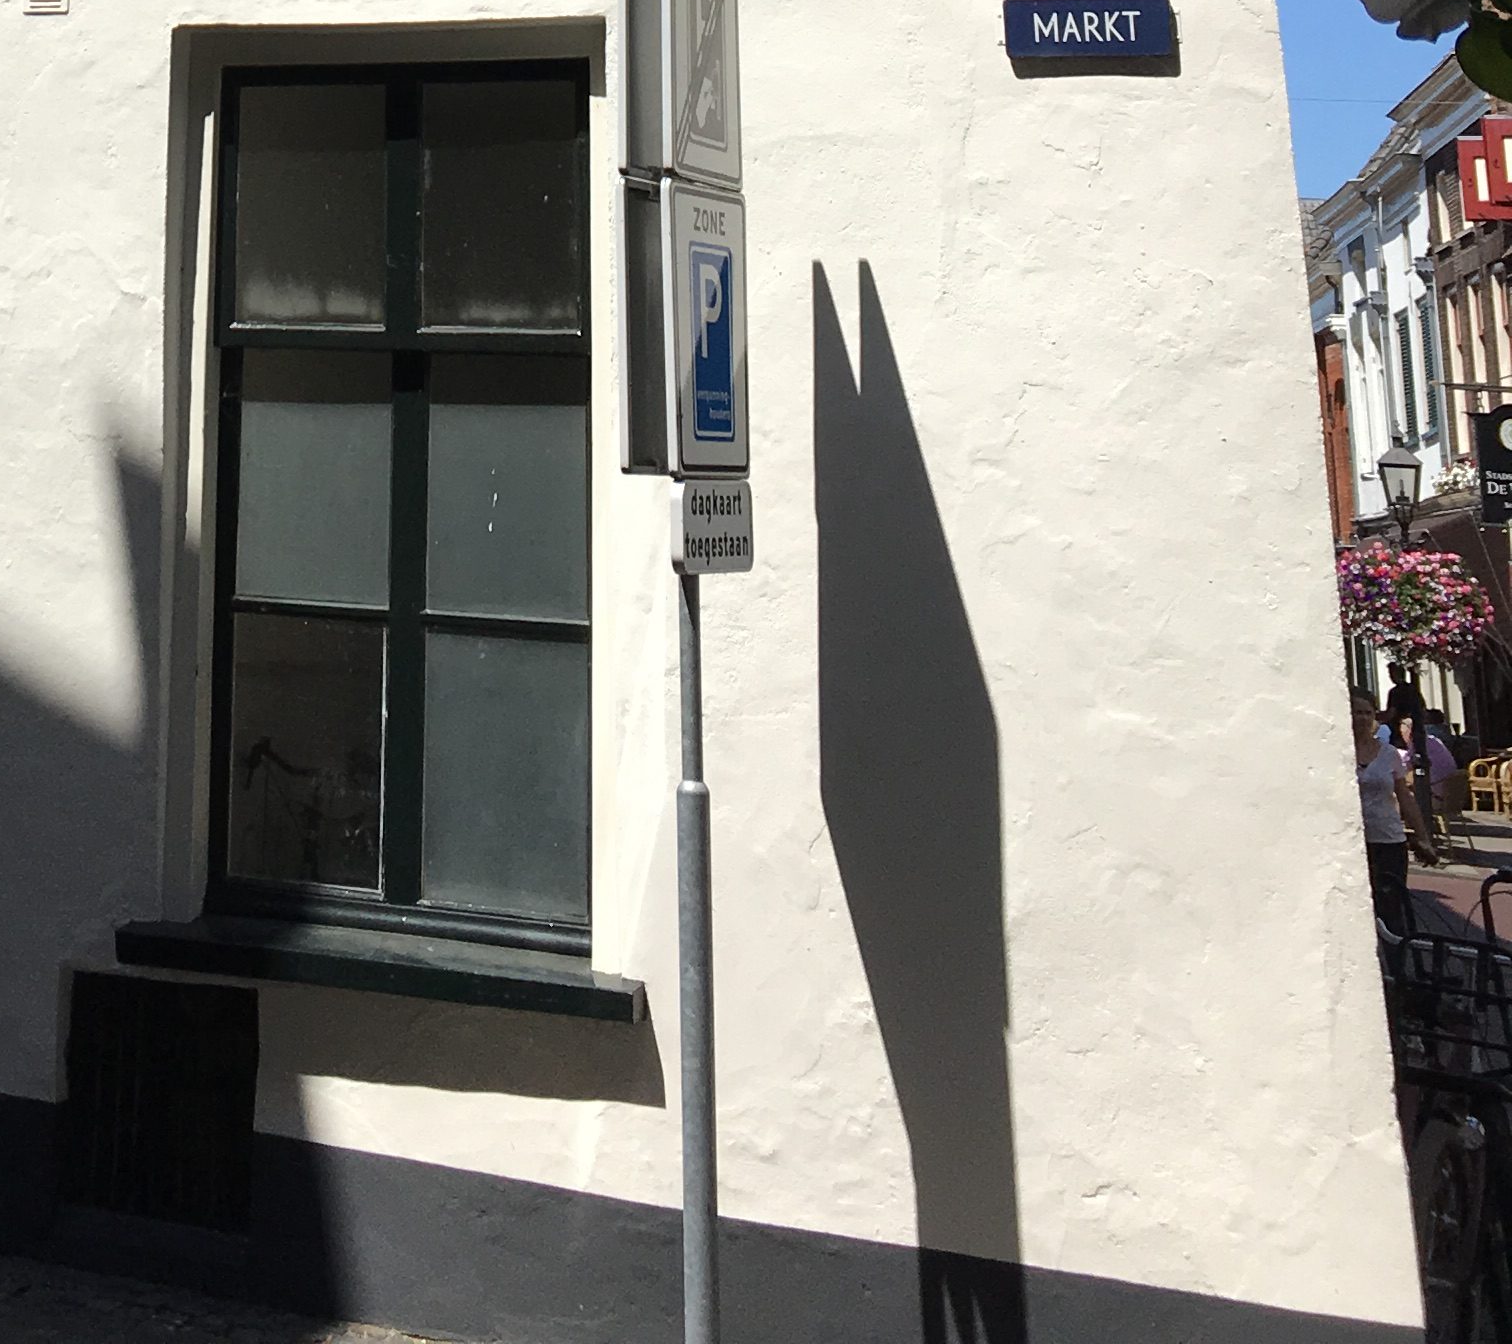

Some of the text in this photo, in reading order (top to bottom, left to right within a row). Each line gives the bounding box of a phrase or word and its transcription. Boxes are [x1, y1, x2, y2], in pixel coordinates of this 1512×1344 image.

[1033, 10, 1141, 43] MARKT
[693, 207, 726, 236] ZONE
[699, 263, 723, 359] P
[691, 488, 742, 524] dagkaart
[685, 531, 749, 567] toegestaan
